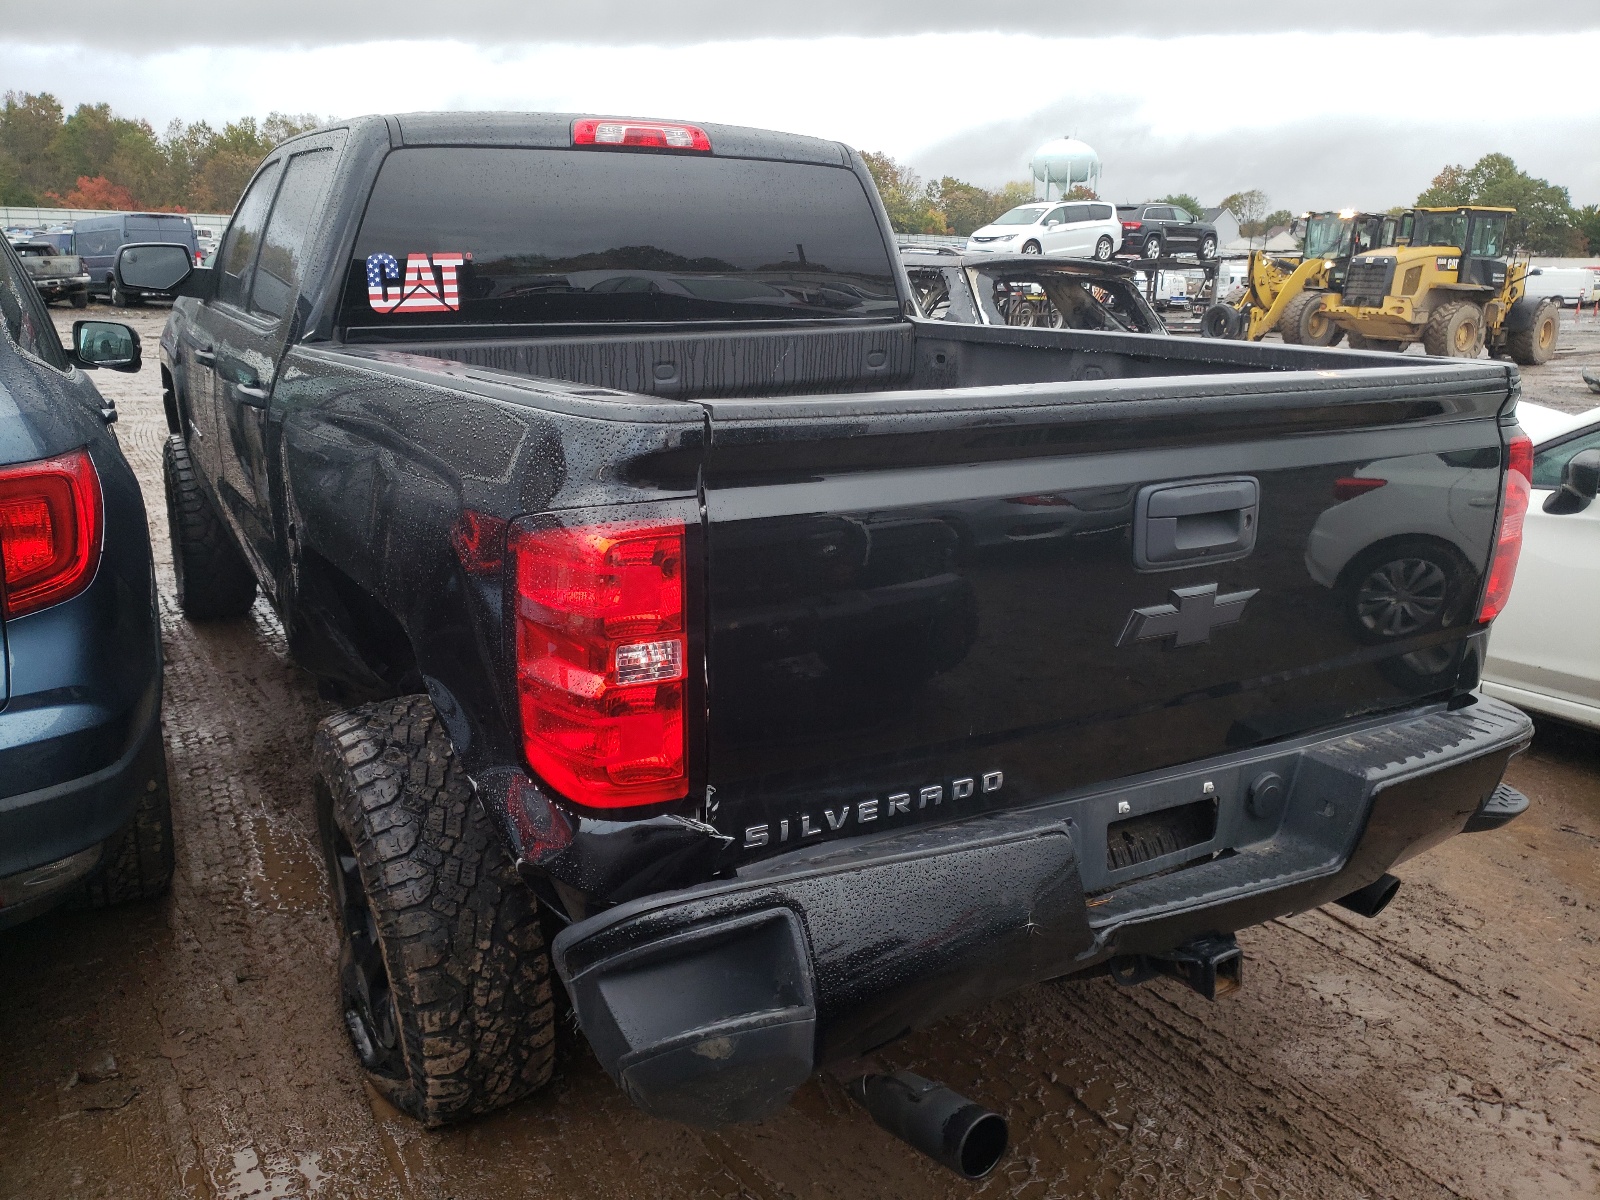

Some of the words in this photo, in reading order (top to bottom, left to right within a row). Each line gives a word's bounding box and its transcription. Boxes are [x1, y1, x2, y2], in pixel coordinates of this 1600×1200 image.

[366, 252, 464, 314] CAT
[1447, 258, 1460, 270] CAT
[743, 770, 1004, 849] SILVERADO
